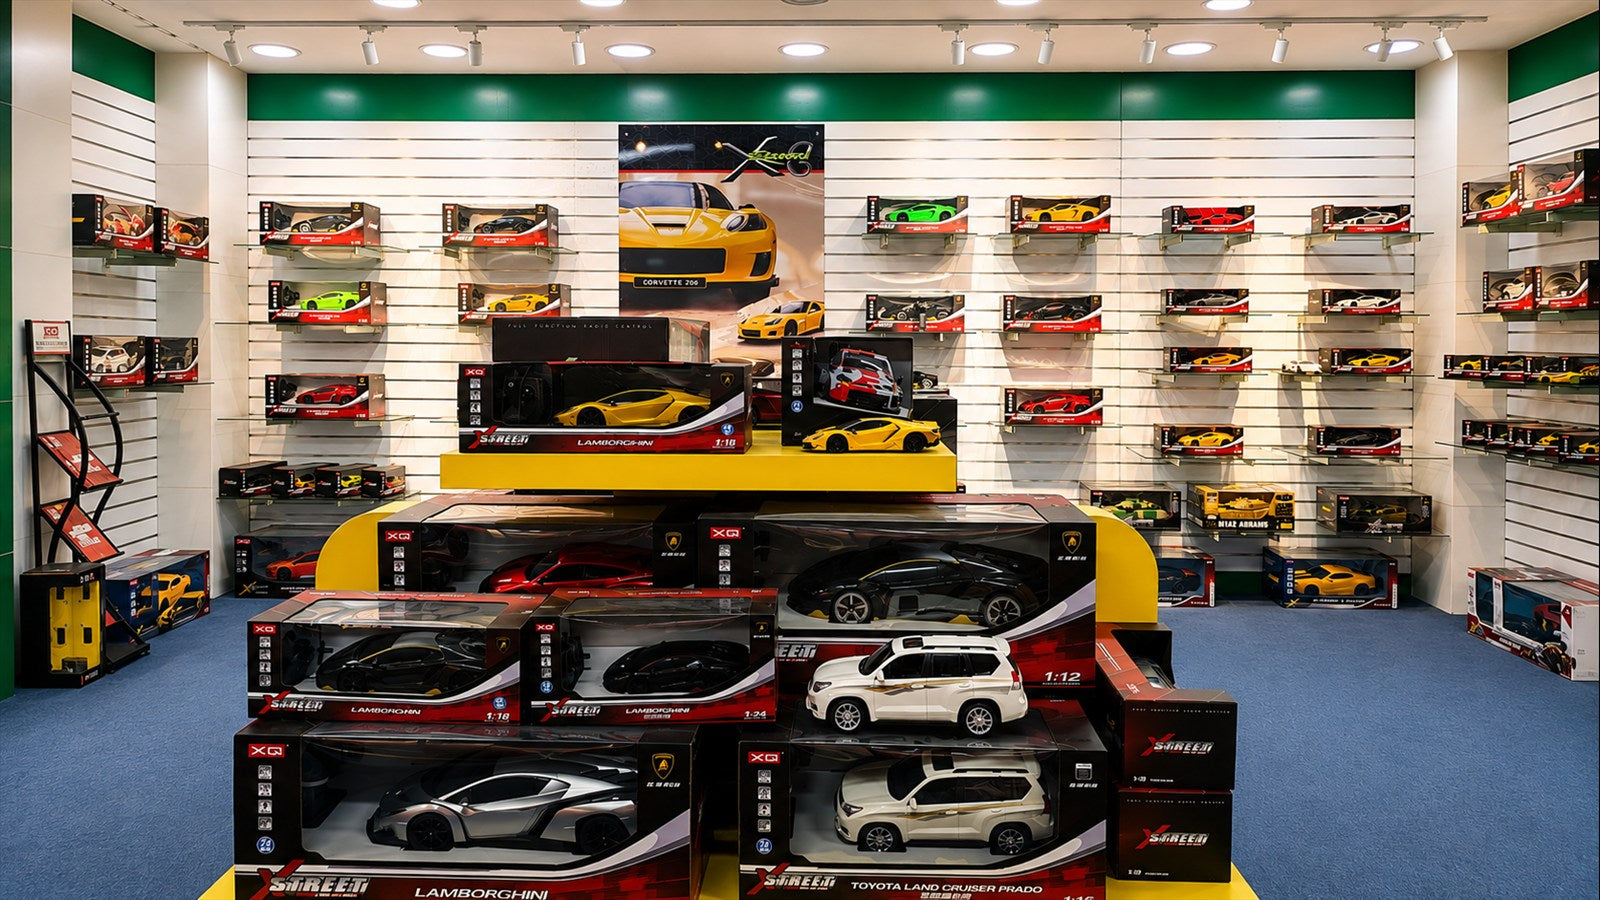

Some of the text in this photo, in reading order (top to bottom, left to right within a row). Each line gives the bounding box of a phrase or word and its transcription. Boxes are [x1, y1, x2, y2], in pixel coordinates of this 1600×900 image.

[387, 532, 411, 540] XQ
[713, 529, 739, 537] XQ
[1045, 671, 1081, 682] 1:12
[251, 745, 283, 756] XQ
[751, 753, 778, 762] XQ
[850, 881, 902, 891] TOYOTA
[904, 883, 940, 891] LAND
[942, 884, 997, 893] CRUISER
[414, 887, 550, 900] LAMBORGHINI
